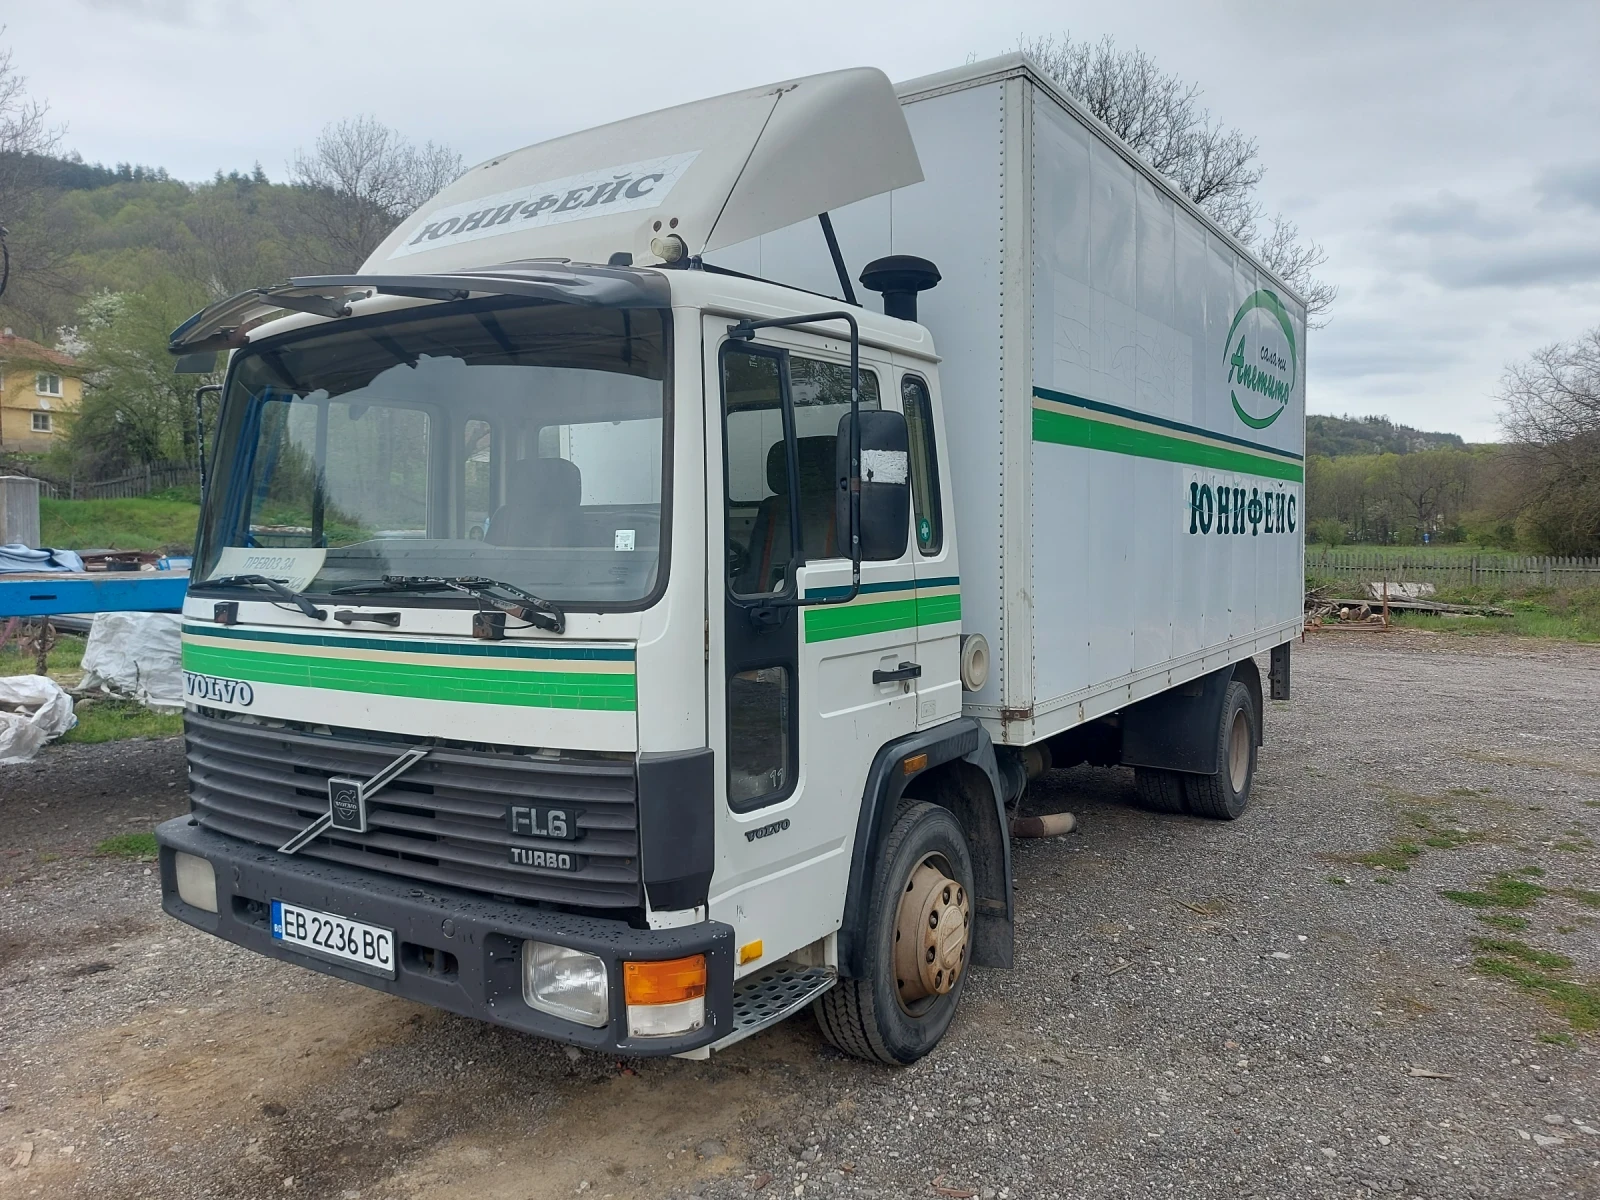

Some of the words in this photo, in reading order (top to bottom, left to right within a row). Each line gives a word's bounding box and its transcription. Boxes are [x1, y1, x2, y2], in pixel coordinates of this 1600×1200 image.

[409, 171, 665, 246] ЮНИФЕЙС
[1189, 480, 1297, 537] ЮНИФЕЙС
[242, 556, 281, 570] ПРЕВОЗ
[280, 557, 296, 571] ЗА
[182, 670, 255, 707] VOLVO
[335, 801, 357, 810] VOLVO
[511, 806, 568, 838] FL6
[744, 818, 791, 843] VOLVO
[511, 847, 571, 870] TURBO
[284, 908, 308, 941] EB
[311, 916, 359, 955] 2236
[362, 929, 389, 965] BC
